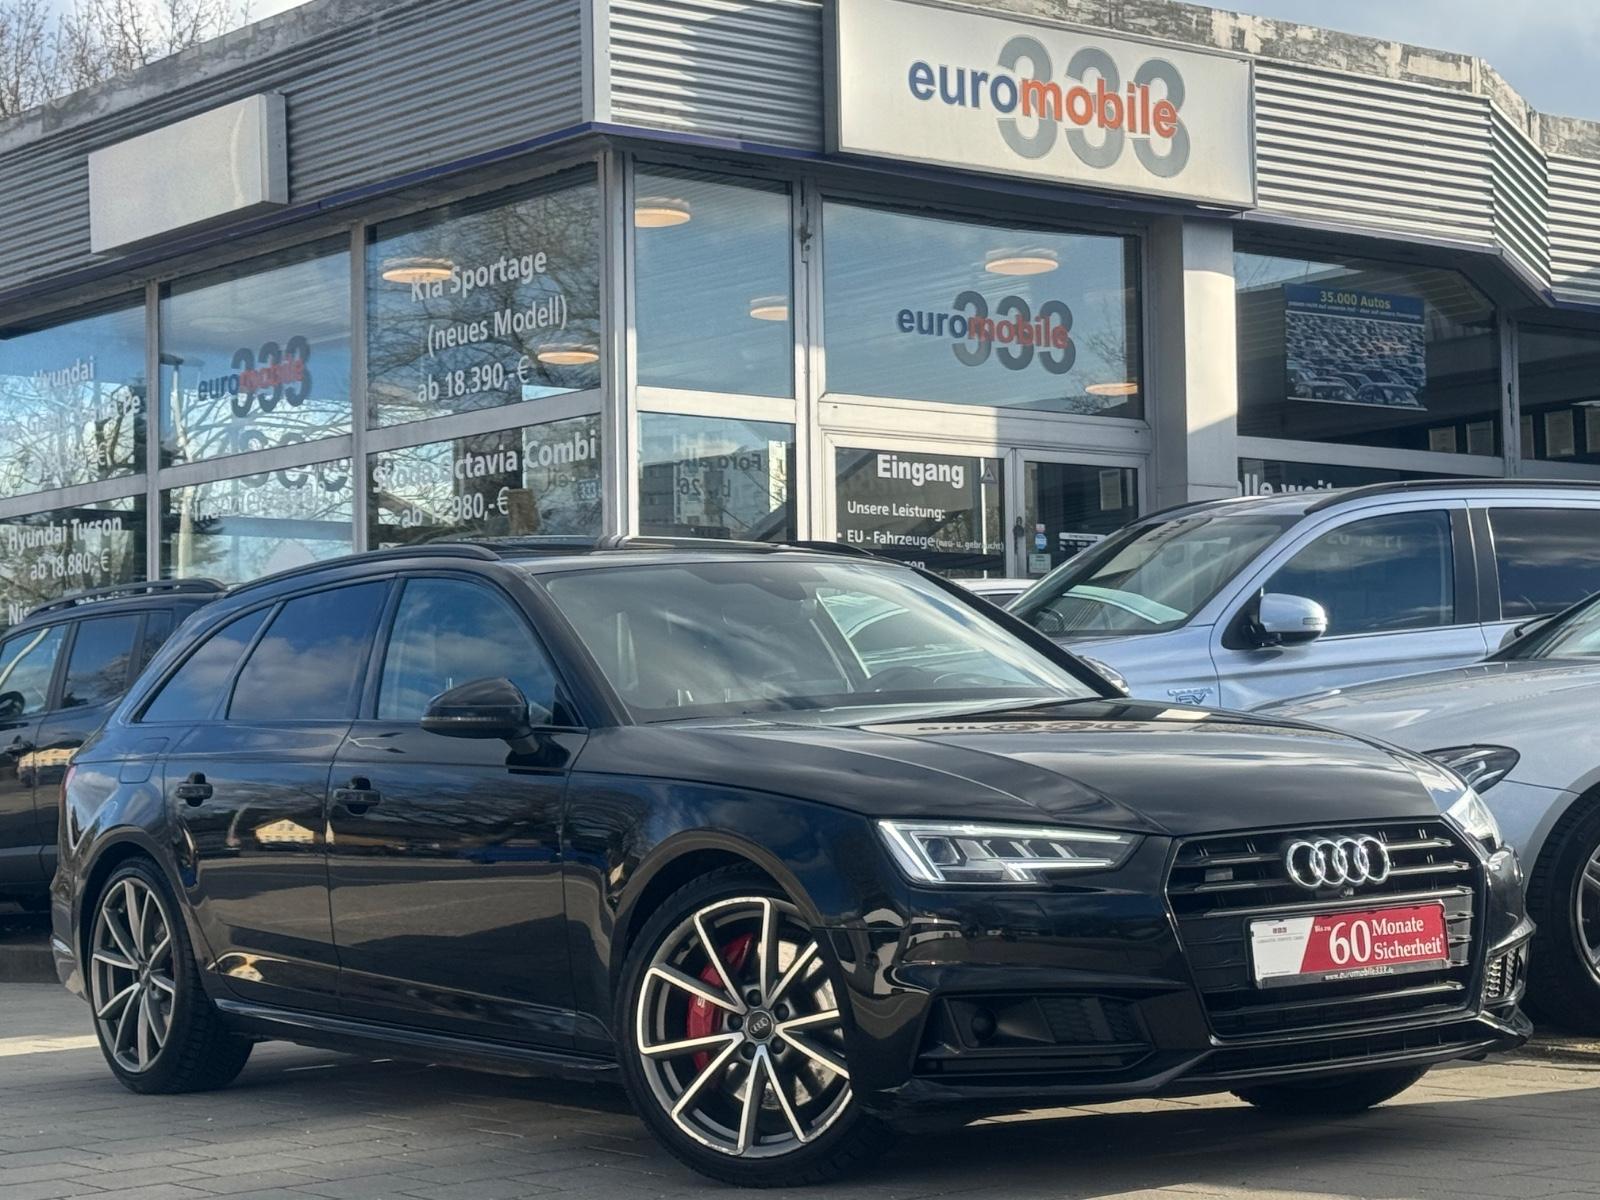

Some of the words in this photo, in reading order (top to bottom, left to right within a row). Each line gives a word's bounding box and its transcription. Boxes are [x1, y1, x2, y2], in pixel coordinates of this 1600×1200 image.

[908, 60, 1178, 139] euromobile
[998, 34, 1191, 178] 333
[411, 271, 443, 302] Kia
[450, 251, 548, 298] Sportage
[1319, 290, 1358, 306] 35.000
[1361, 295, 1391, 310] Autos
[427, 319, 488, 357] (neues
[494, 294, 568, 336] Modell)
[897, 308, 1069, 350] euromobile
[952, 290, 1077, 375] 333
[231, 335, 313, 418] 333
[417, 373, 439, 403] ab
[525, 430, 597, 468] Combi
[877, 453, 964, 489] Eingang
[401, 505, 424, 529] ab
[847, 500, 889, 516] Unsere
[892, 503, 946, 522] Leistung:
[8, 519, 67, 556] Hyundai
[71, 516, 122, 541] Tucson
[846, 529, 864, 543] EU
[873, 530, 934, 550] Fahrzeuge
[30, 558, 46, 581] ab
[1329, 920, 1372, 965] 60
[1371, 916, 1424, 937] Monate
